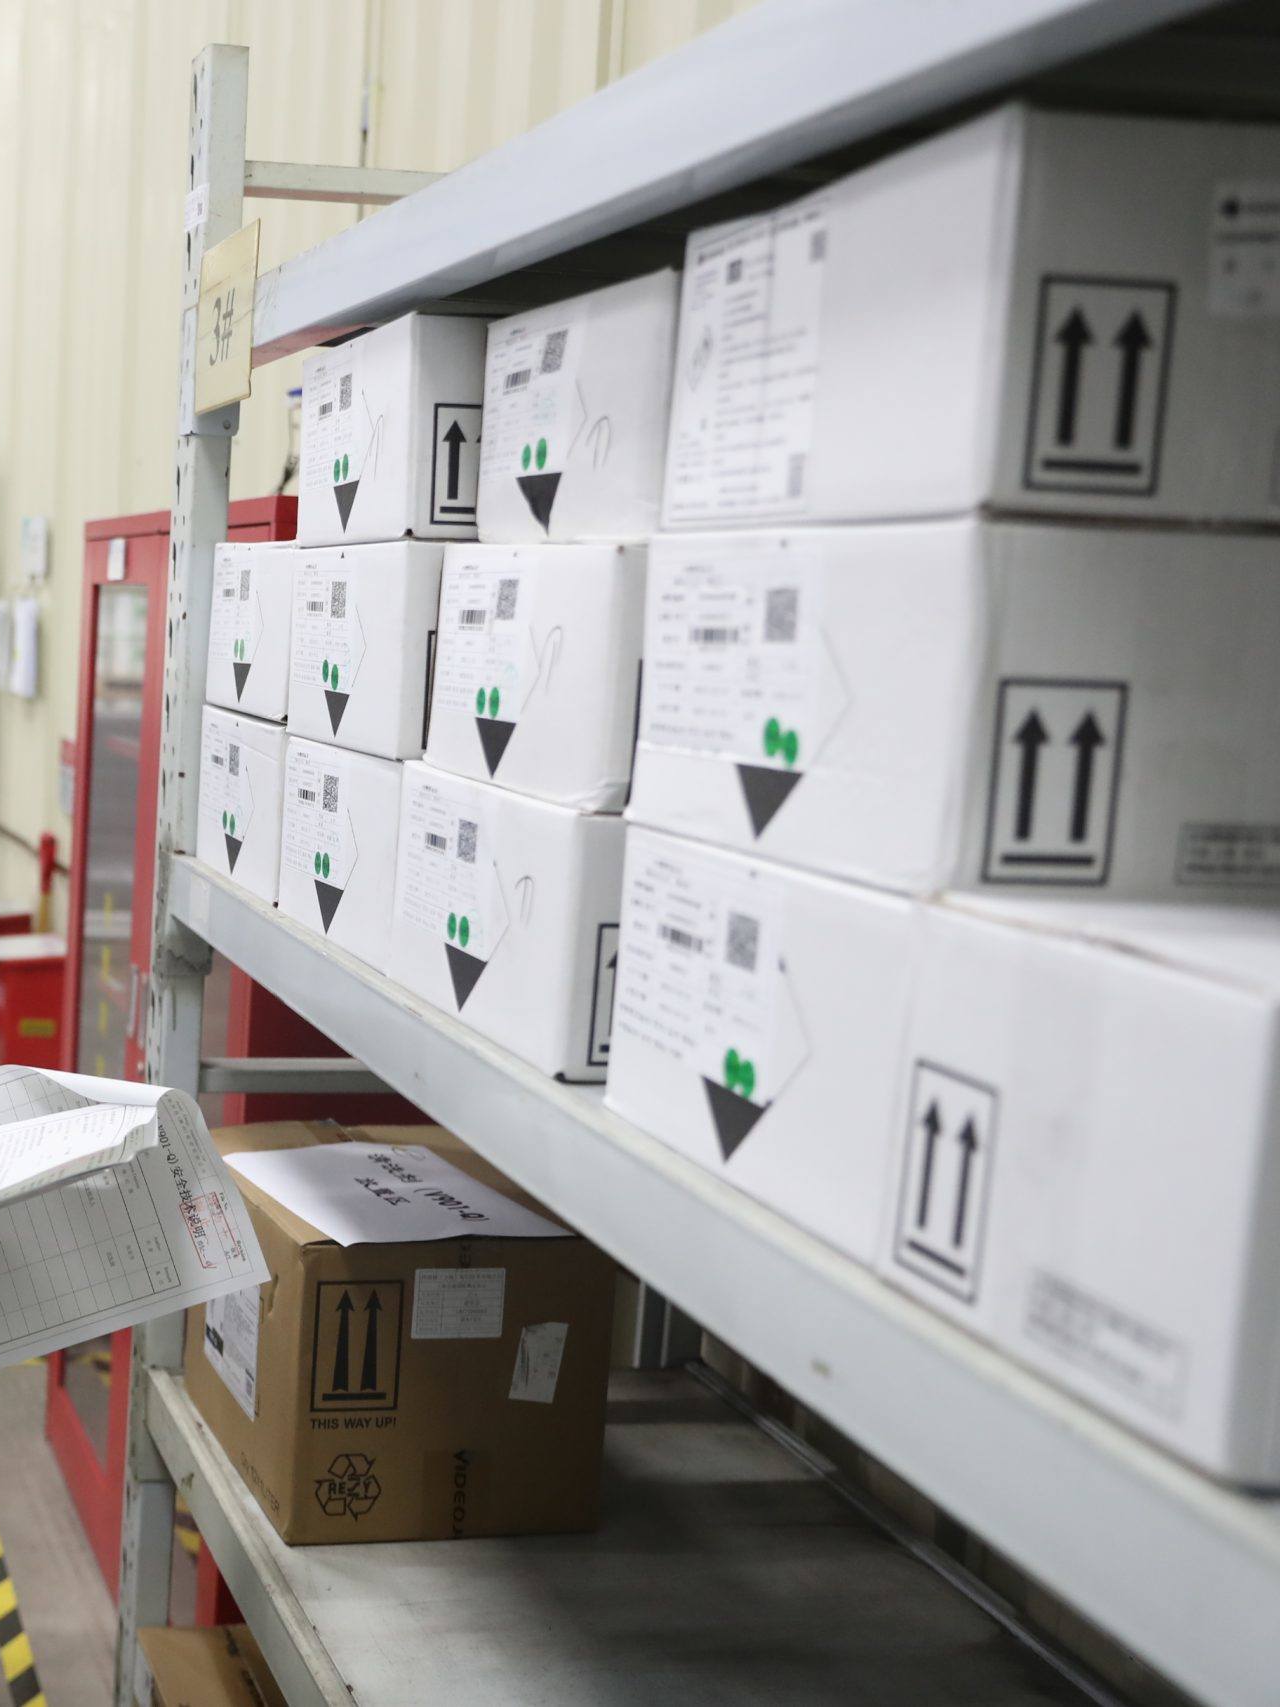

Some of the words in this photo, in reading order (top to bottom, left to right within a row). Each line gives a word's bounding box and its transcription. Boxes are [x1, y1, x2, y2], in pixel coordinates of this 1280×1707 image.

[209, 287, 236, 367] 3#
[309, 1418, 340, 1430] THIS
[343, 1417, 373, 1430] WAY
[375, 1416, 397, 1429] UP!
